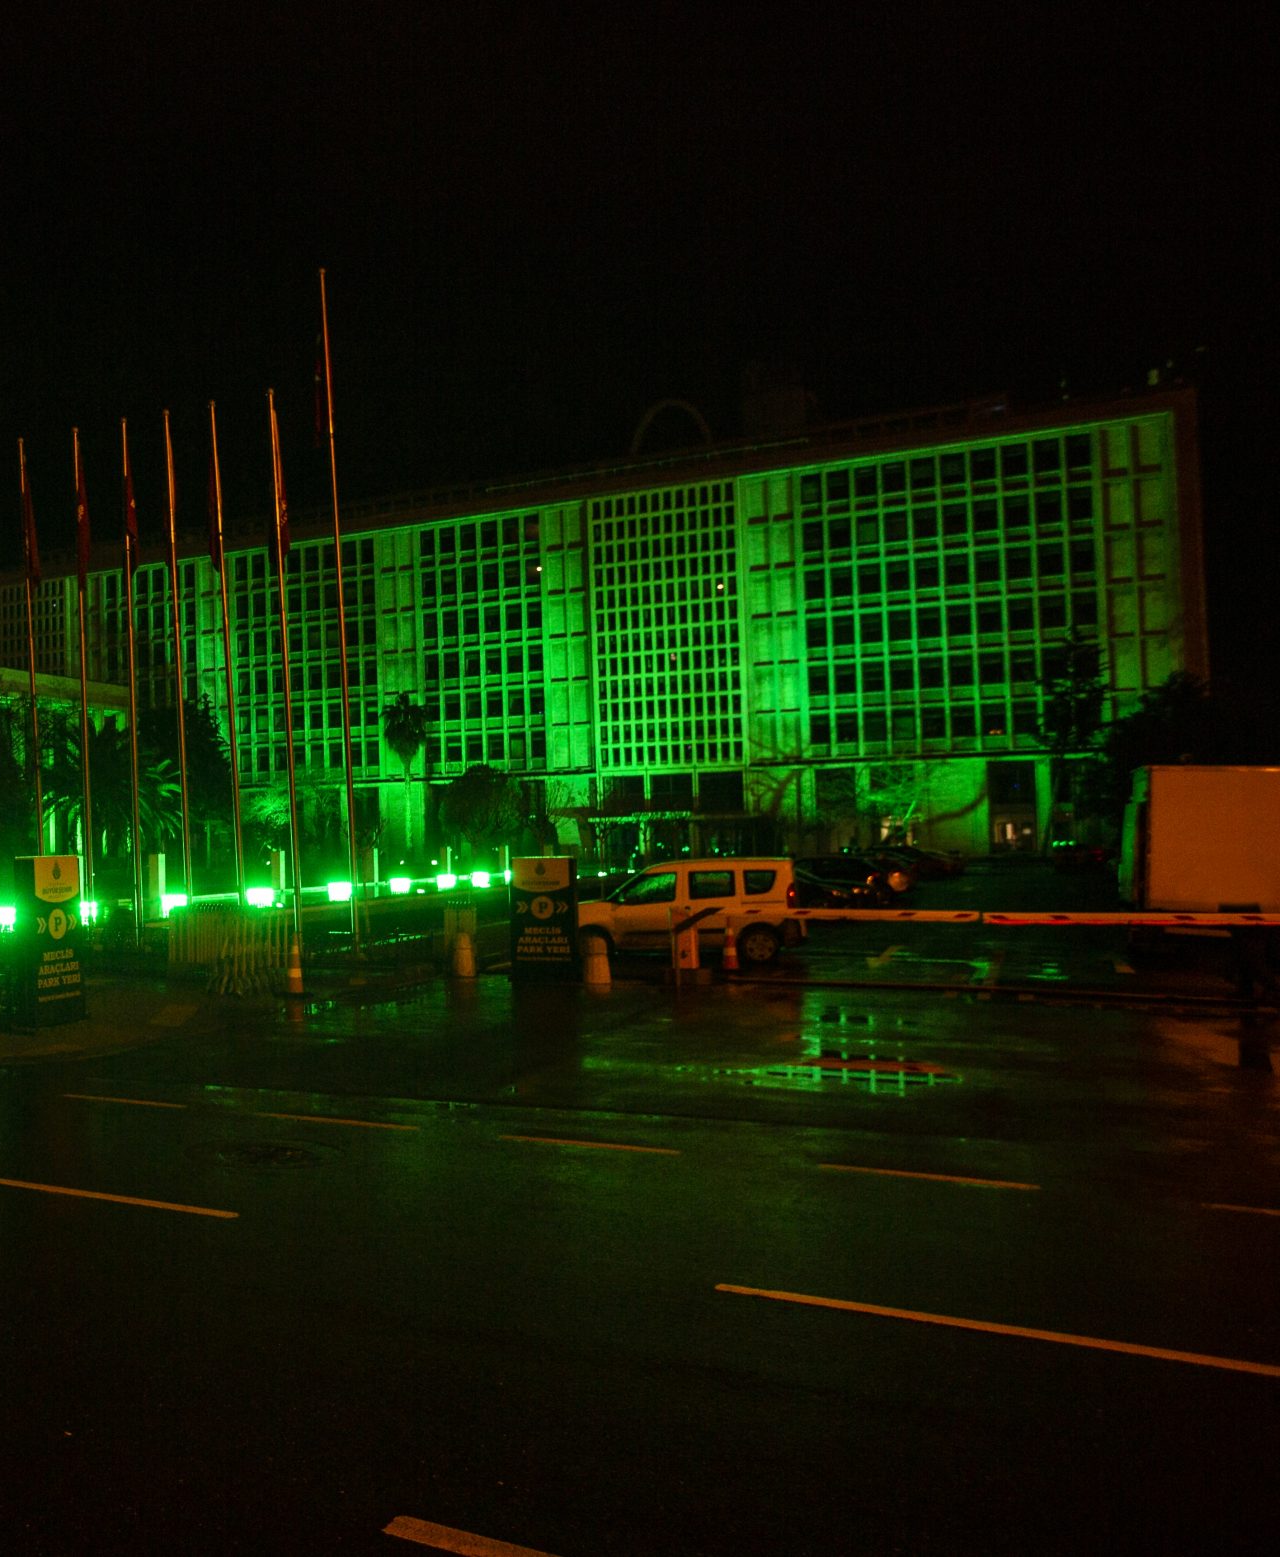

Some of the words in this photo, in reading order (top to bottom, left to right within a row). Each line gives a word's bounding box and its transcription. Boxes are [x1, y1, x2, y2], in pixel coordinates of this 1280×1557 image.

[539, 902, 547, 913] P
[54, 917, 62, 931] P
[517, 945, 543, 953] PARK
[38, 976, 60, 989] PARK
